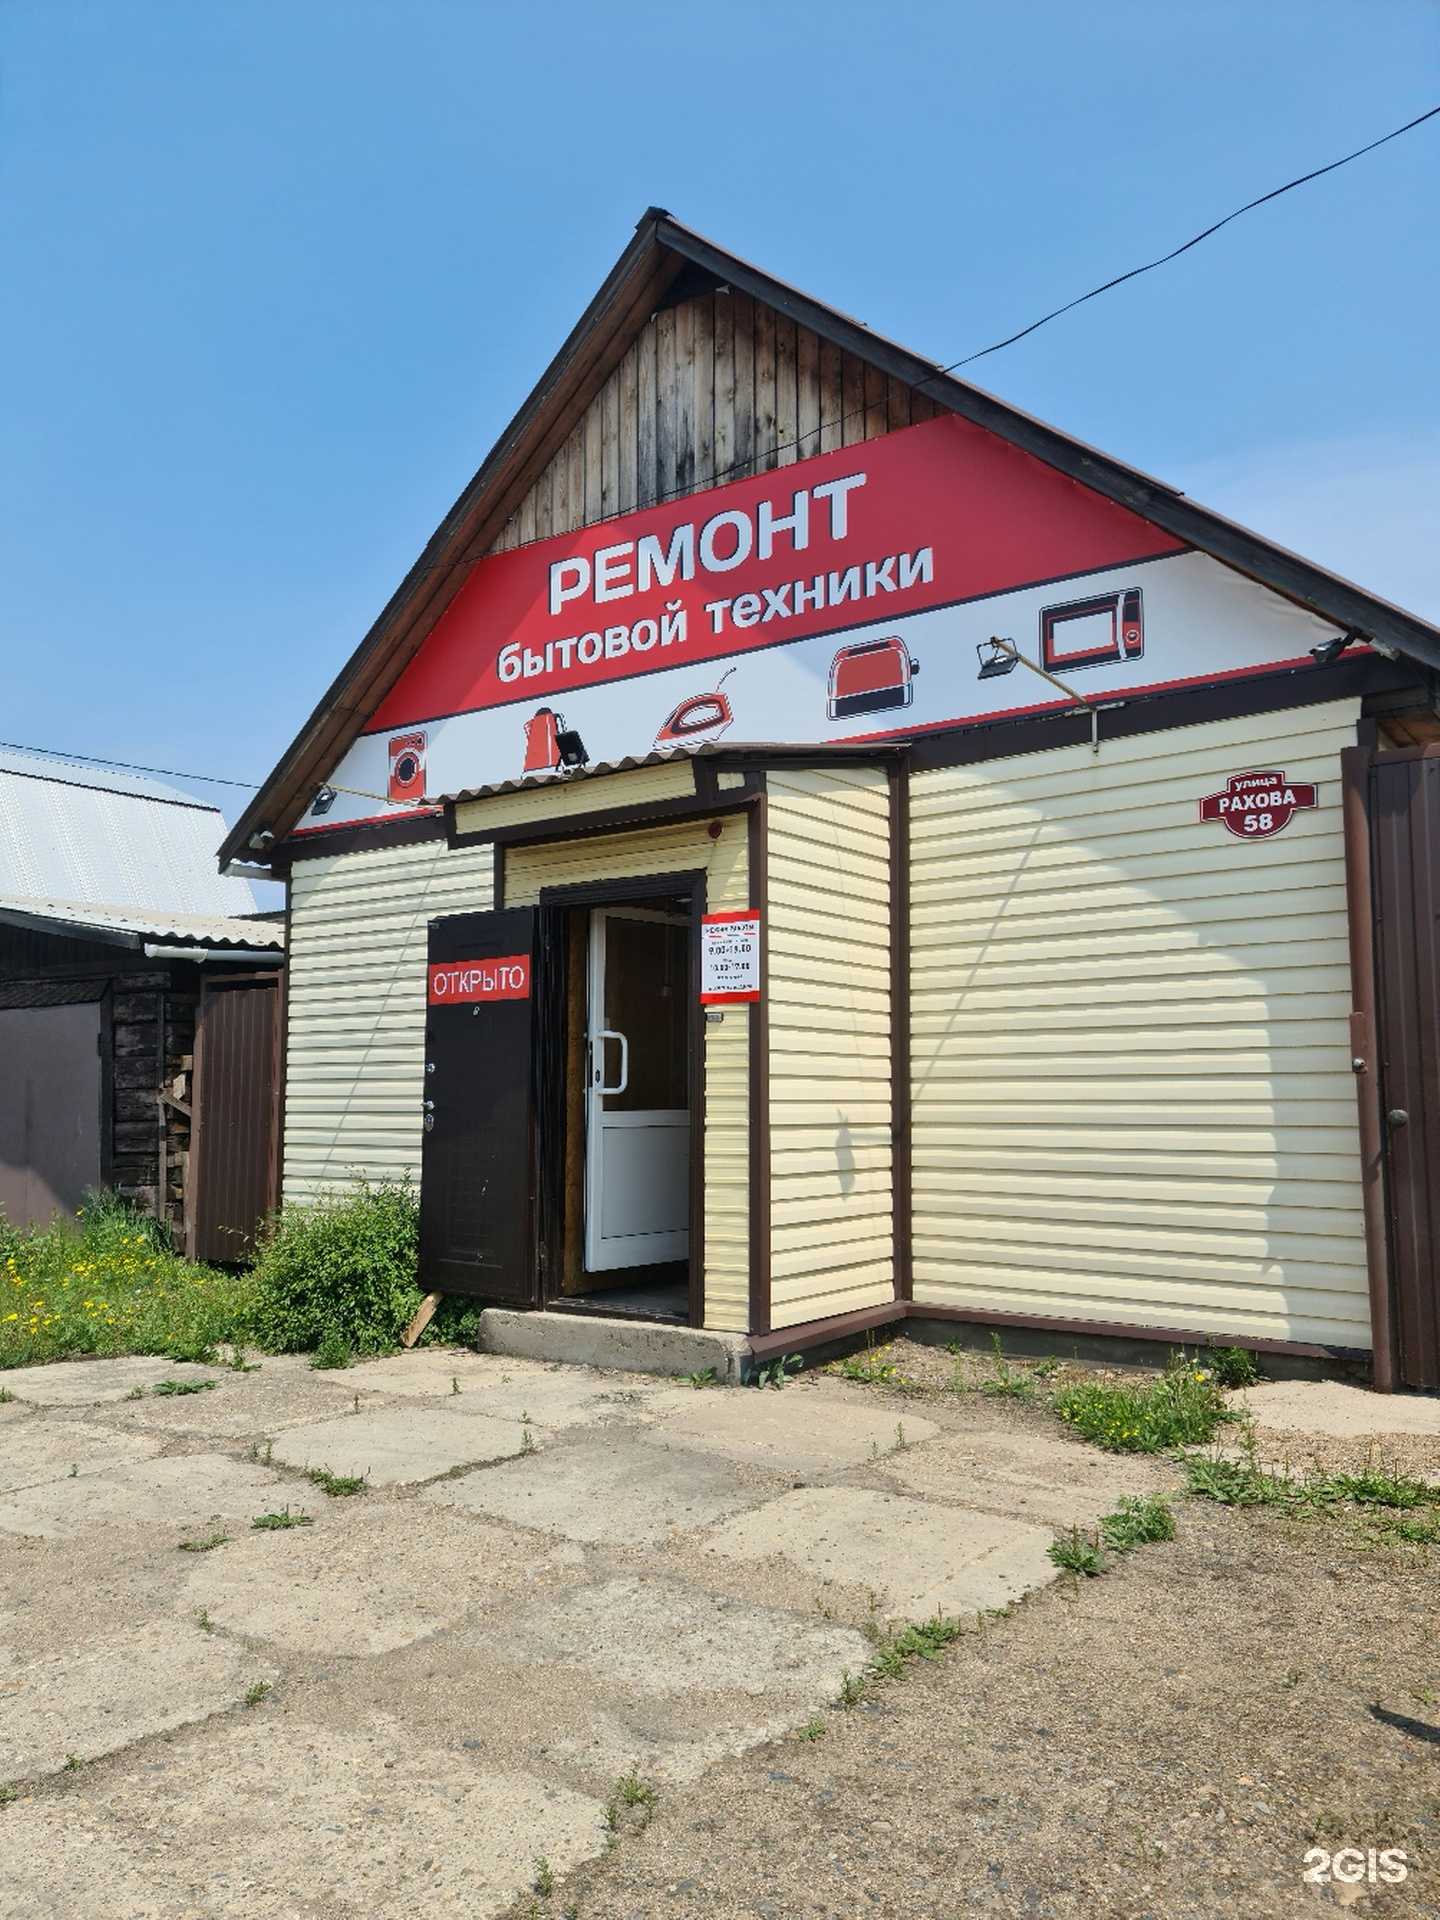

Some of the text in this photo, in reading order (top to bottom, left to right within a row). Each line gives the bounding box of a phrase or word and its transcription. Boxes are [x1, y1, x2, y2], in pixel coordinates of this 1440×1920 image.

[549, 472, 867, 615] РЕМОНТ
[498, 547, 934, 683] бытовой техники
[1235, 776, 1278, 791] улица
[1219, 789, 1297, 813] РАХОВА
[1244, 813, 1273, 832] 58
[434, 965, 525, 996] ОТКРЫТО
